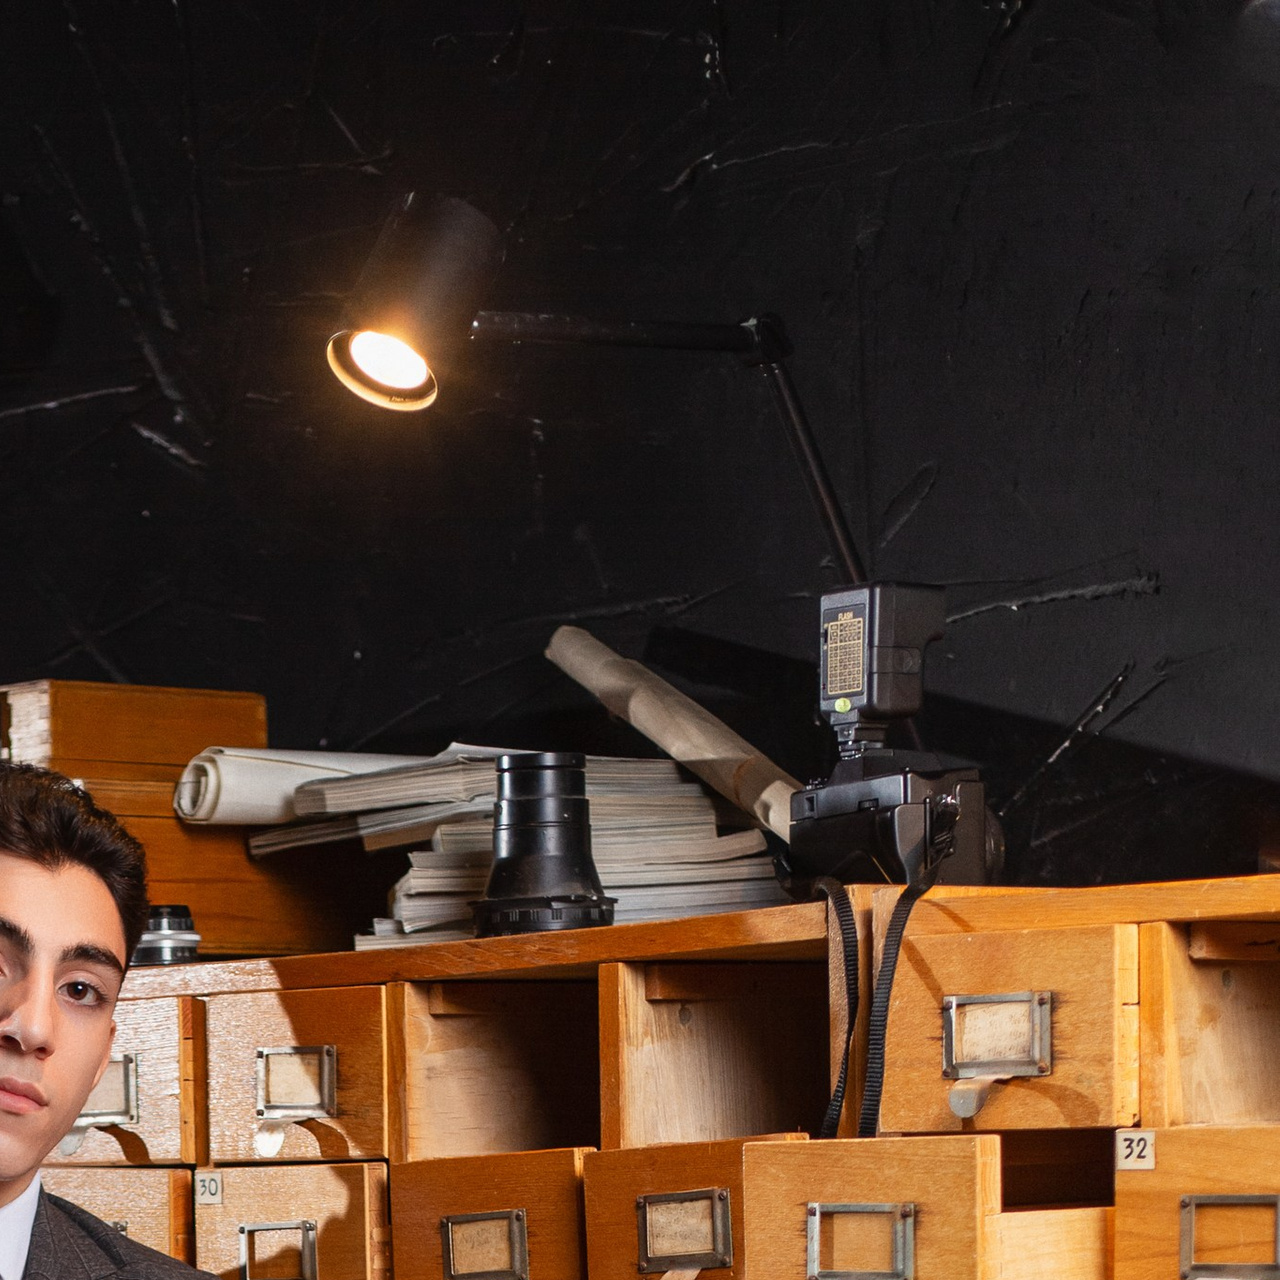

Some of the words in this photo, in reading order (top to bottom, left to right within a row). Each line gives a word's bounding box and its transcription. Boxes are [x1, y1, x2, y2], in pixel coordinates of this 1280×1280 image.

[838, 611, 854, 621] FLASH
[1123, 1137, 1148, 1160] 32
[199, 1178, 218, 1197] 30
